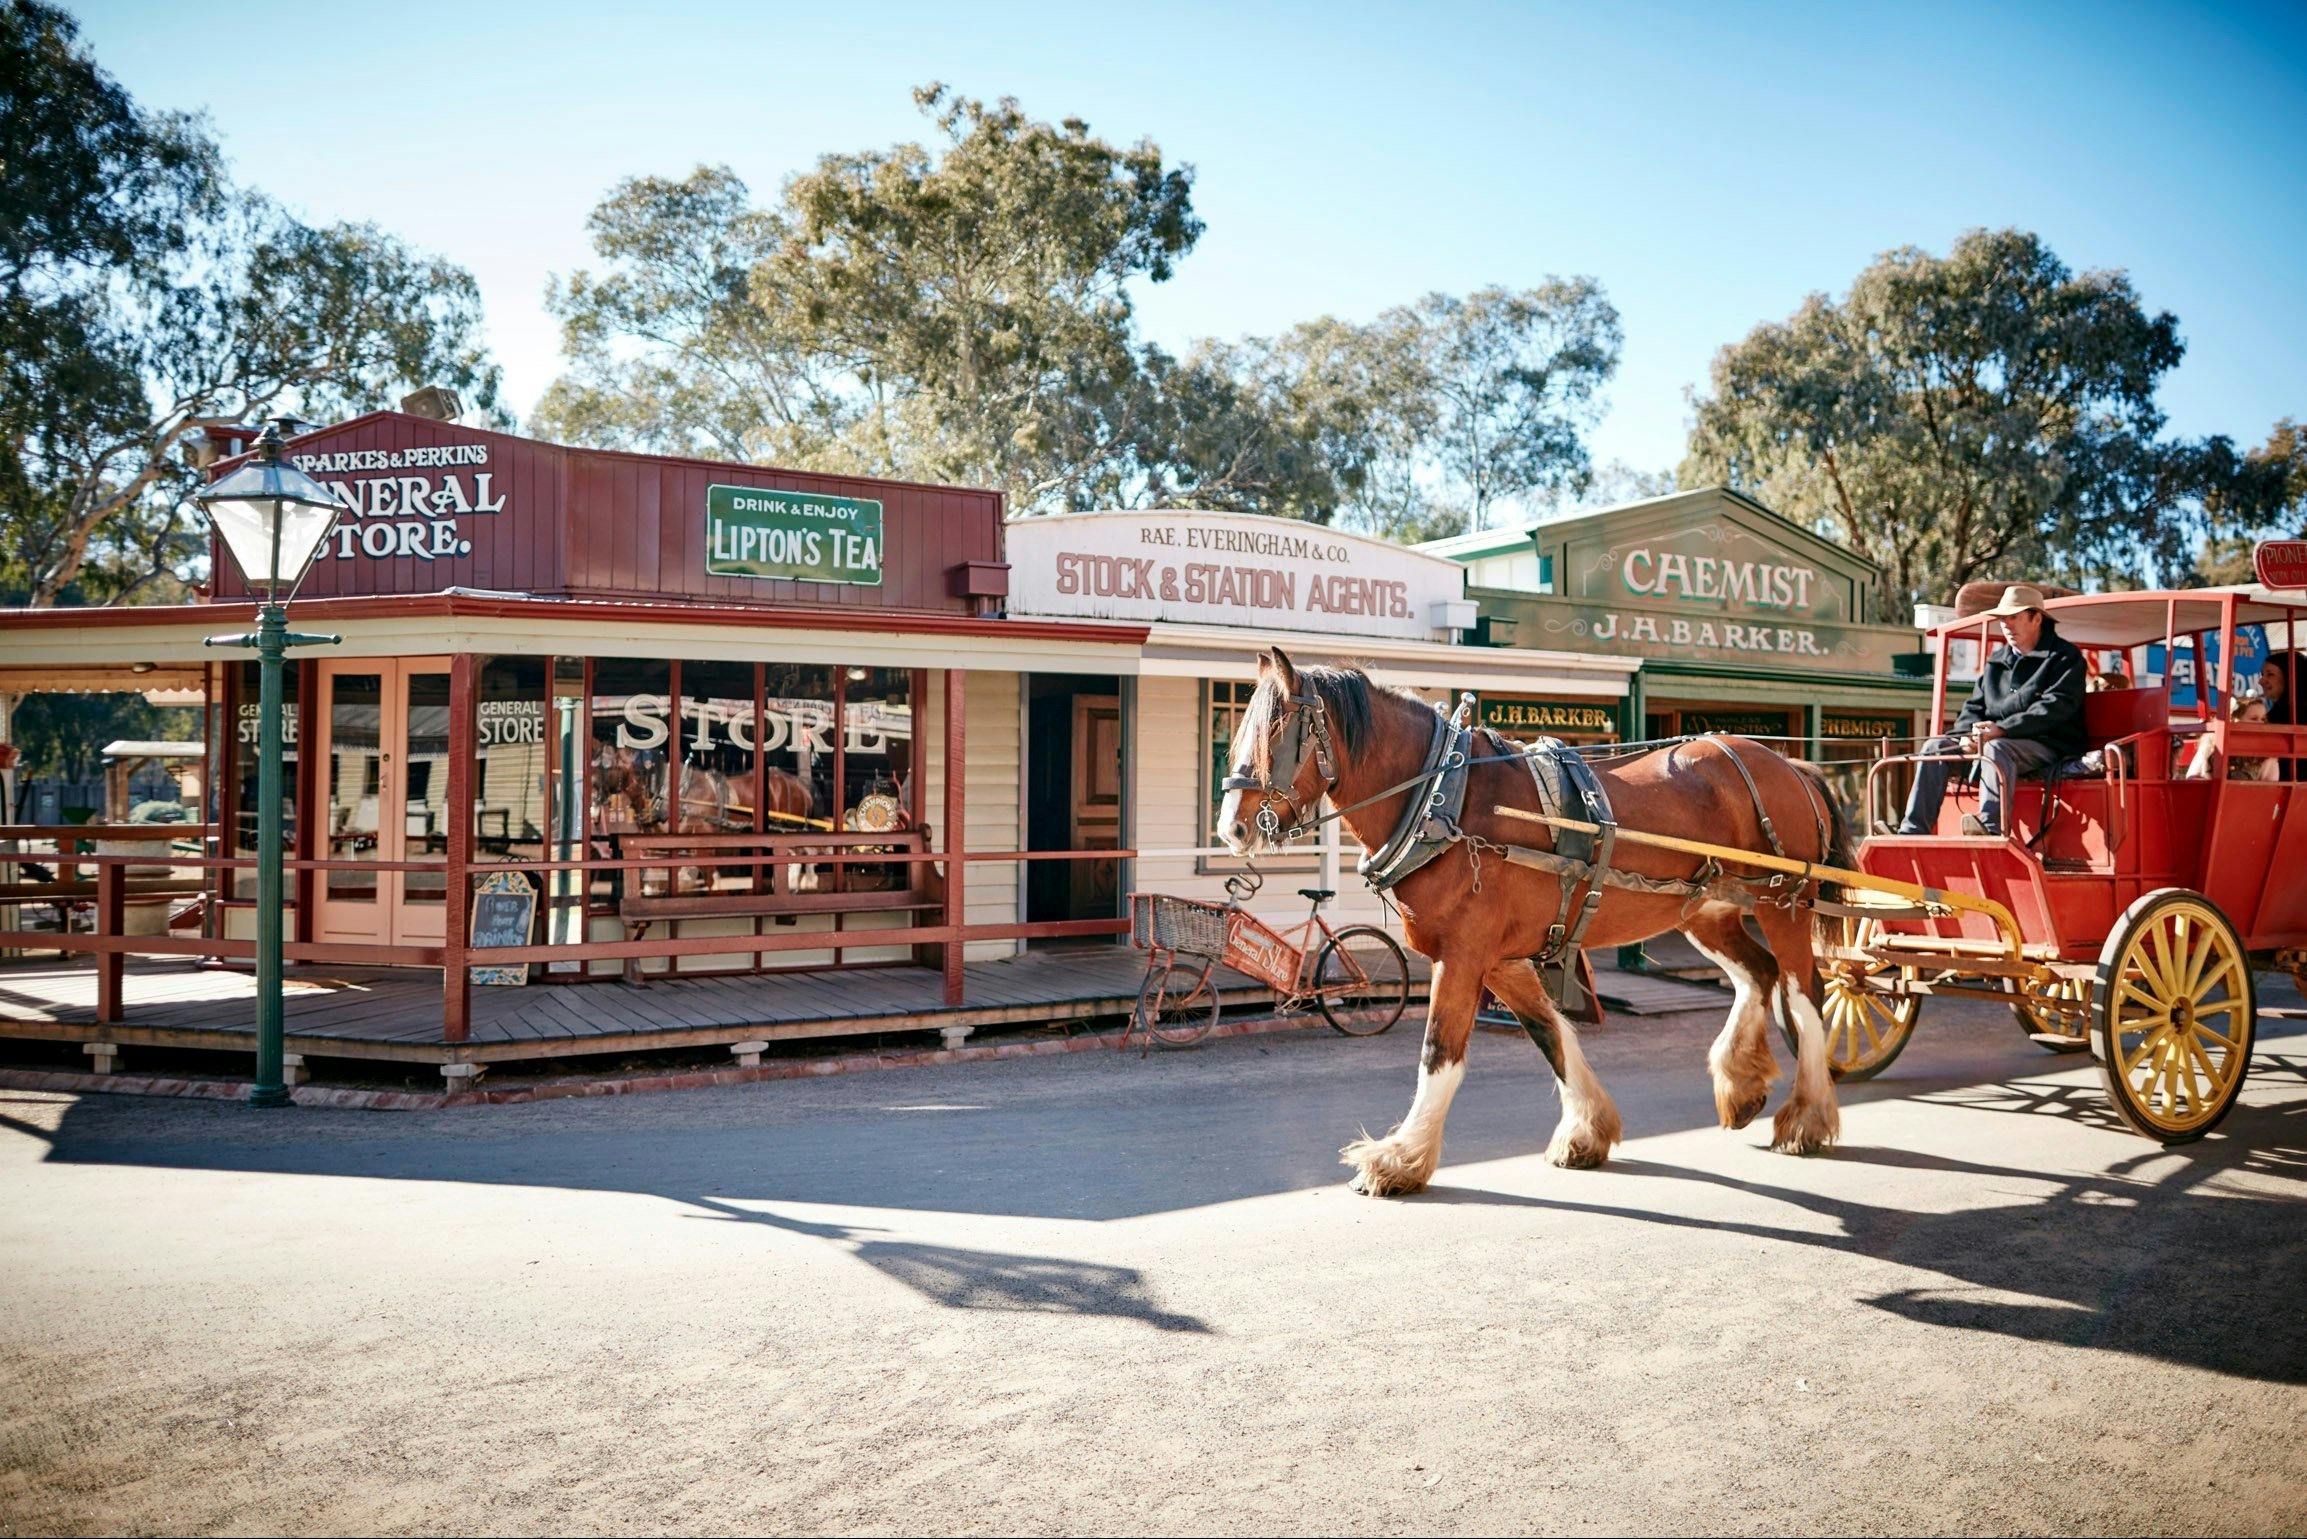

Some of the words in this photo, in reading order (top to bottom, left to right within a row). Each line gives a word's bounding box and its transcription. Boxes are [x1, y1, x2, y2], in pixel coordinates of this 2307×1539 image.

[292, 450, 389, 473] SPARKES
[390, 453, 403, 468] &
[403, 445, 488, 468] PERKINS
[319, 473, 507, 519] NERAL
[733, 497, 787, 514] DRINK
[790, 504, 801, 516] &
[804, 503, 859, 520] ENJOY
[714, 518, 822, 566] LIPTON'S
[829, 527, 878, 570] TEA
[1141, 528, 1181, 548] RAE.
[1187, 528, 1308, 559] EVERINGHAM
[1312, 543, 1324, 559] &
[1327, 545, 1351, 563] CO.
[1056, 552, 1156, 600] STOCK
[1160, 566, 1182, 602] &
[1185, 562, 1296, 609] STATION
[1306, 574, 1415, 619] AGENTS.
[1622, 549, 1815, 609] CHEMIST
[238, 703, 297, 717] GENAL
[480, 701, 541, 715] GENERAL
[616, 693, 887, 755] STORE
[238, 718, 299, 743] STRE
[479, 717, 545, 744] STORE
[1229, 918, 1265, 963] General
[1262, 942, 1289, 982] Store
